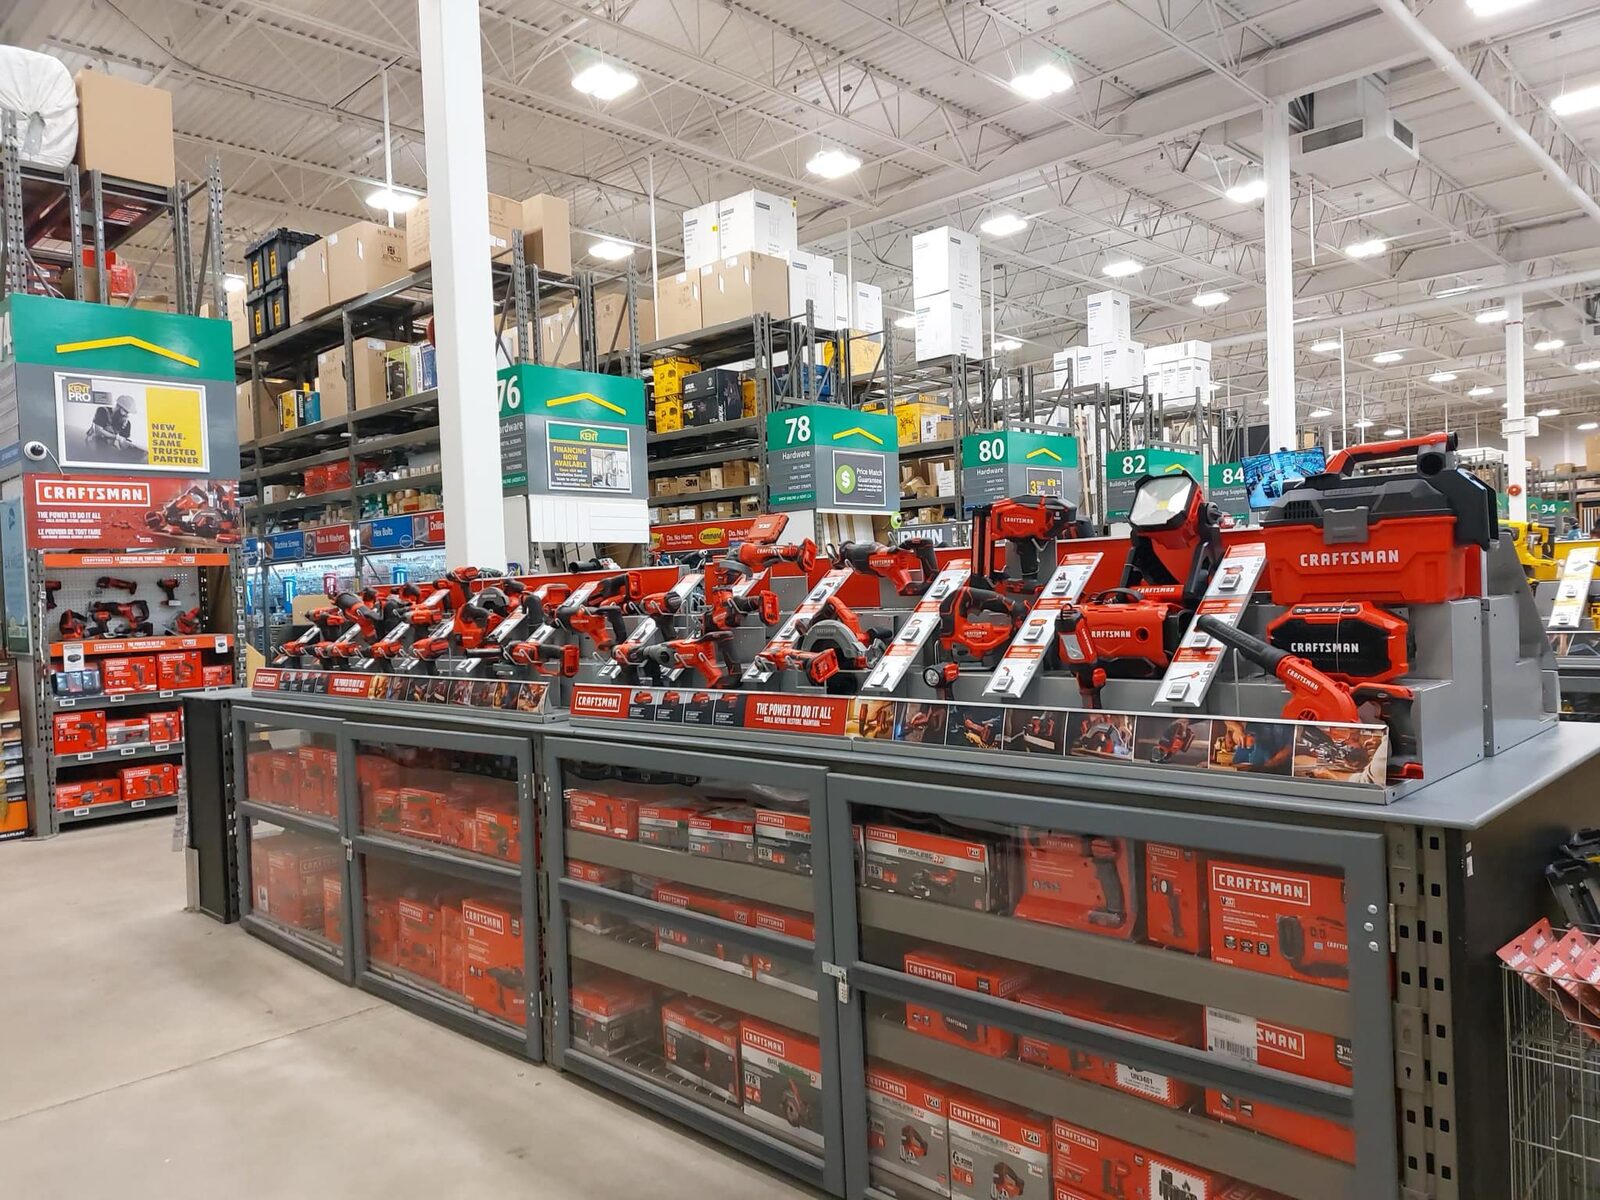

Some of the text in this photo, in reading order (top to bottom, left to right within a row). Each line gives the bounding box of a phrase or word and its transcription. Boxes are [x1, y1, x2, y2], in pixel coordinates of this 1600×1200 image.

[68, 392, 91, 402] PRO
[498, 375, 521, 412] 76
[152, 423, 176, 431] NEW
[785, 416, 811, 444] 78
[152, 431, 186, 440] NAME.
[580, 432, 598, 441] KENT
[153, 448, 197, 456] TRUSTED
[553, 446, 586, 454] FINANCING
[782, 450, 810, 460] Hardware
[979, 438, 1005, 462] 80
[153, 456, 198, 464] PARTNER
[555, 460, 588, 468] AVAILABLE
[1122, 455, 1146, 474] 82
[976, 468, 1004, 476] Hardware
[1222, 467, 1245, 484] 84
[44, 486, 144, 500] CRAFTSMAN
[1030, 480, 1037, 494] 3
[1541, 504, 1556, 514] 94
[382, 527, 393, 536] Bolts
[1300, 550, 1399, 567] CRAFTSMAN
[1290, 642, 1359, 653] CRAFTSMAN
[1287, 668, 1319, 691] CRAFTSMAN
[578, 696, 618, 708] CRAFTSMAN
[756, 703, 831, 719] THE POWER TO DO IT ALL
[758, 815, 784, 826] CRAFTSMAN
[868, 829, 896, 840] CRAFTSMAN
[1218, 874, 1303, 898] CRAFTSMAN
[659, 892, 687, 906] CRAFTSMAN
[465, 908, 501, 930] CRAFTSMAN
[758, 915, 784, 928] CRAFTSMAN
[909, 964, 953, 984] CRAFTSMAN
[745, 1032, 782, 1052] CRAFTSMAN
[1337, 1045, 1343, 1054] 3
[868, 1076, 904, 1096] CRAFTSMAN
[952, 1106, 998, 1130] CRAFTSMAN
[1024, 1130, 1039, 1143] V20
[1058, 1128, 1096, 1148] CRAFTSMAN
